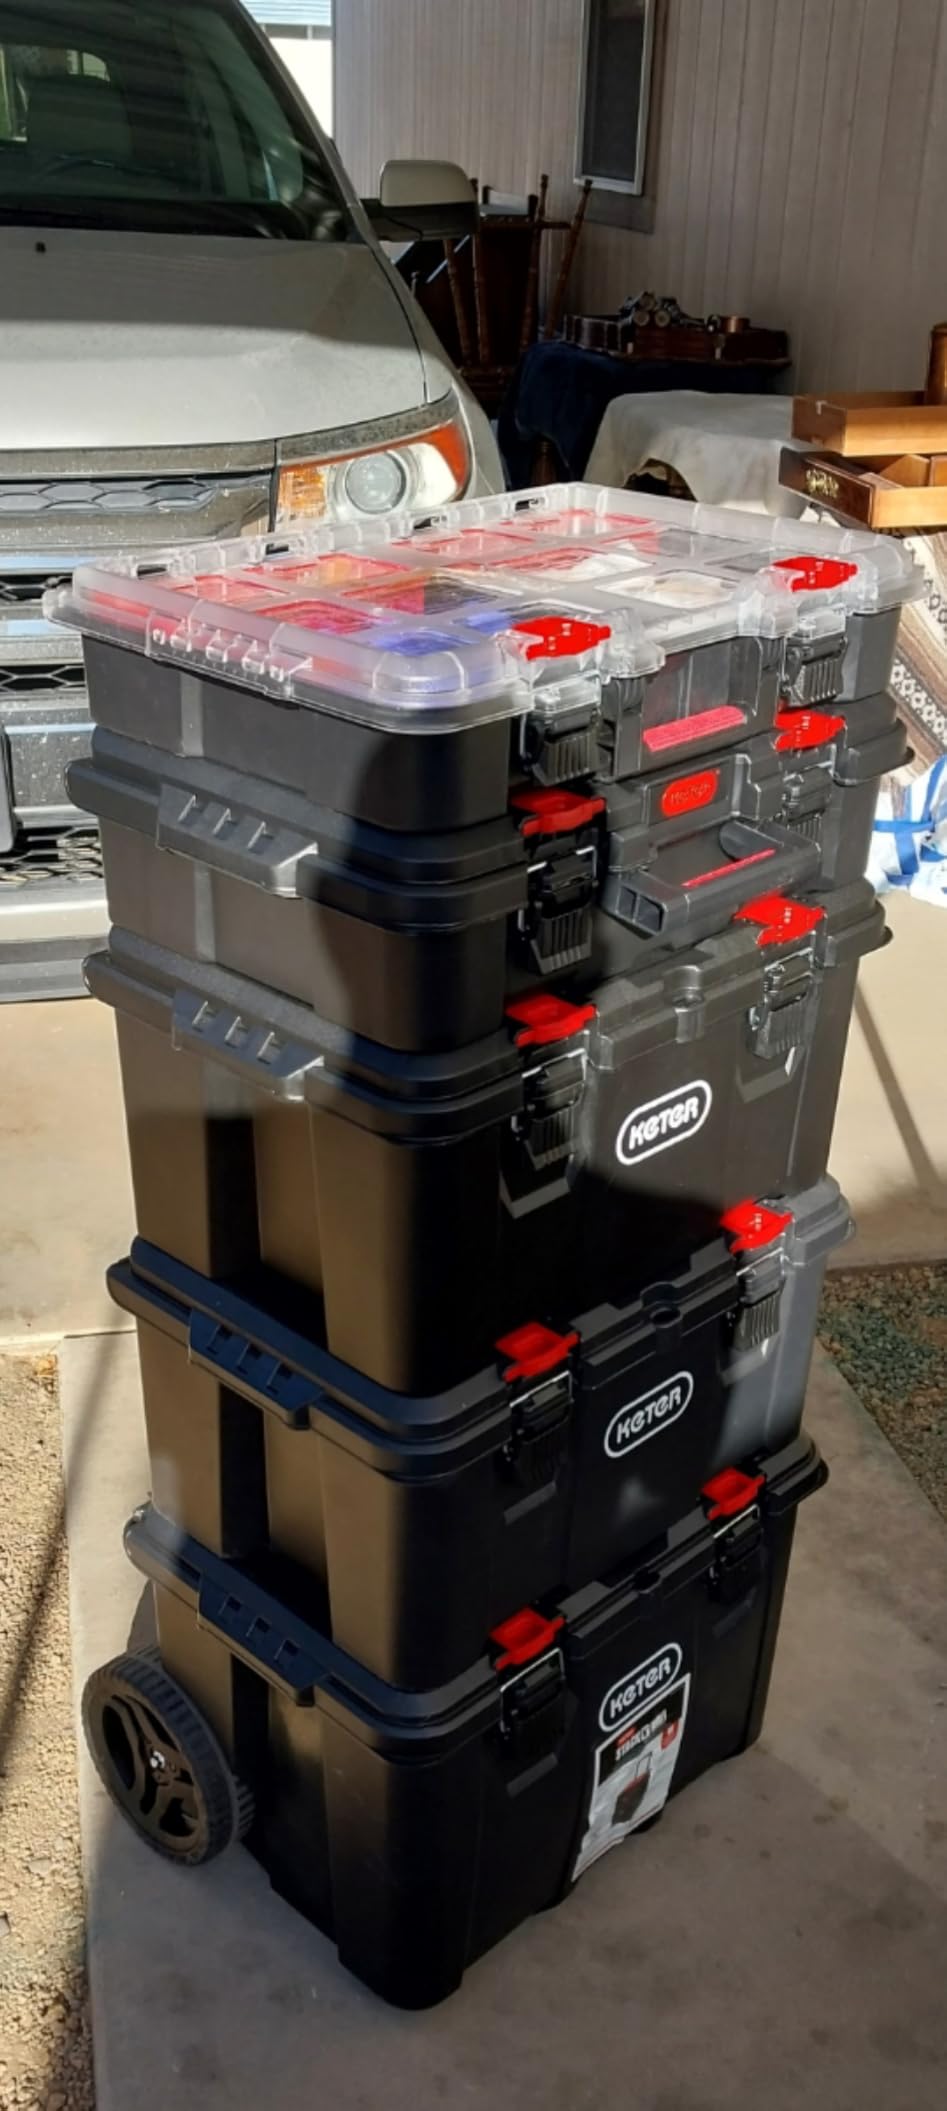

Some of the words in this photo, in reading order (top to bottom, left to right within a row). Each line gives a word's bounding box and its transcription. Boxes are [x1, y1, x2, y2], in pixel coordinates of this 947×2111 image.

[628, 1096, 700, 1150] KETER
[616, 1385, 682, 1444] KETER
[609, 1656, 672, 1719] KETER
